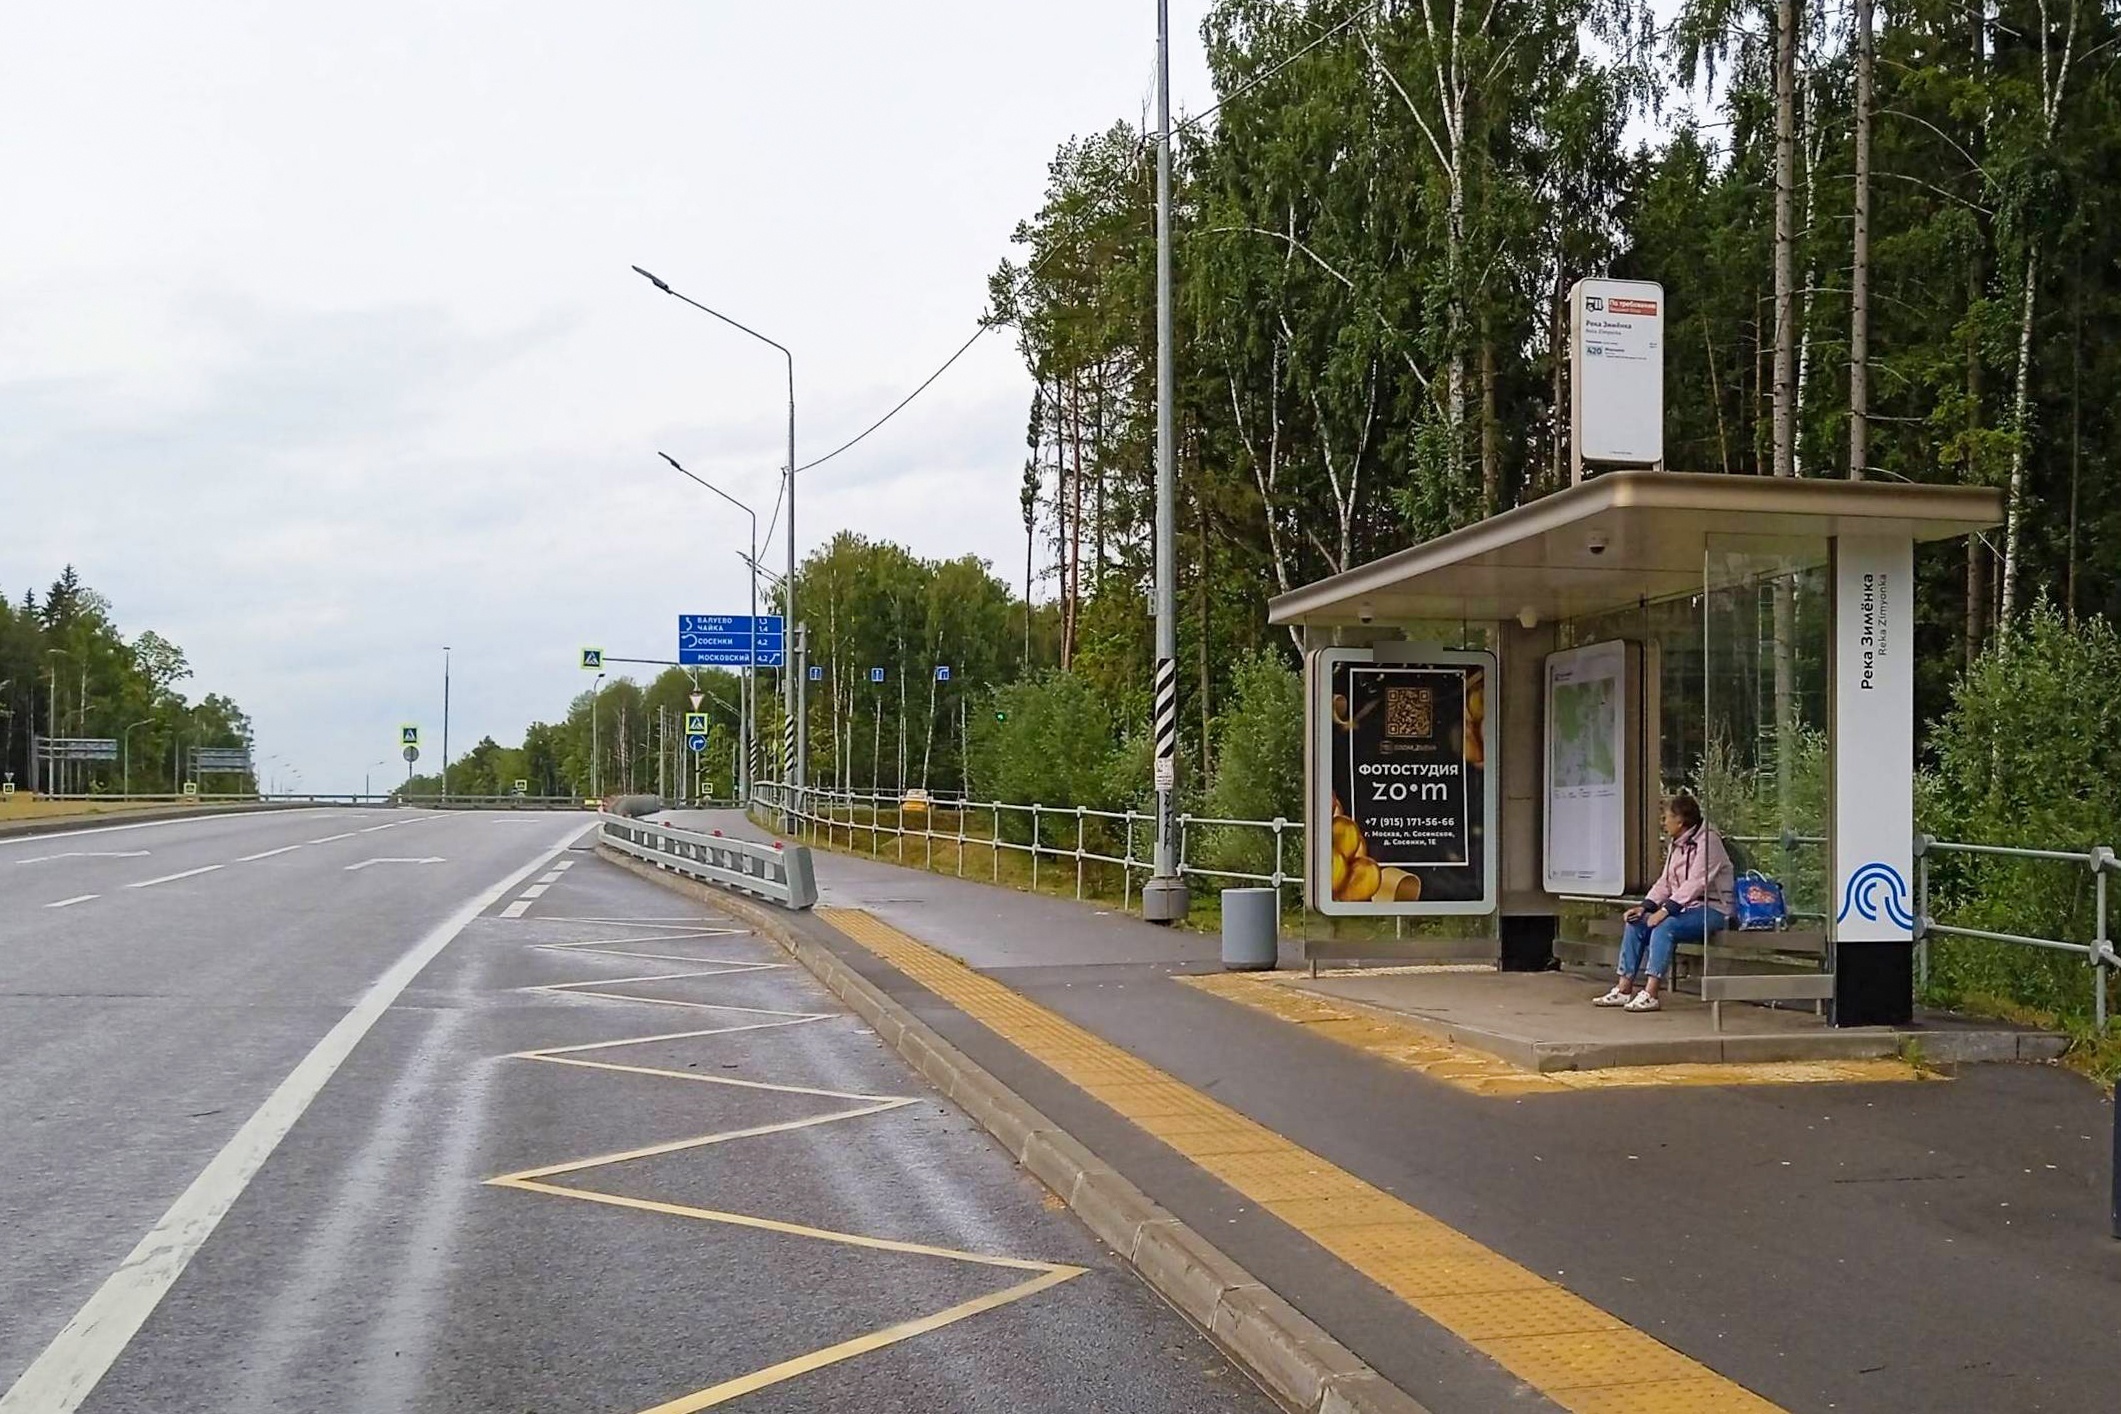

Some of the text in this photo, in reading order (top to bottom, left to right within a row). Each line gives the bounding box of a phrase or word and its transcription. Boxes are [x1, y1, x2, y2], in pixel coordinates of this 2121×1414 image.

[1586, 347, 1602, 355] 420
[1877, 574, 1889, 656] Reka Zimyonka
[1860, 573, 1873, 690] Река Зимёнка
[1358, 763, 1459, 777] ФОТОСТУДИЯ
[1364, 817, 1455, 828] +7 (915) 171-56-66
